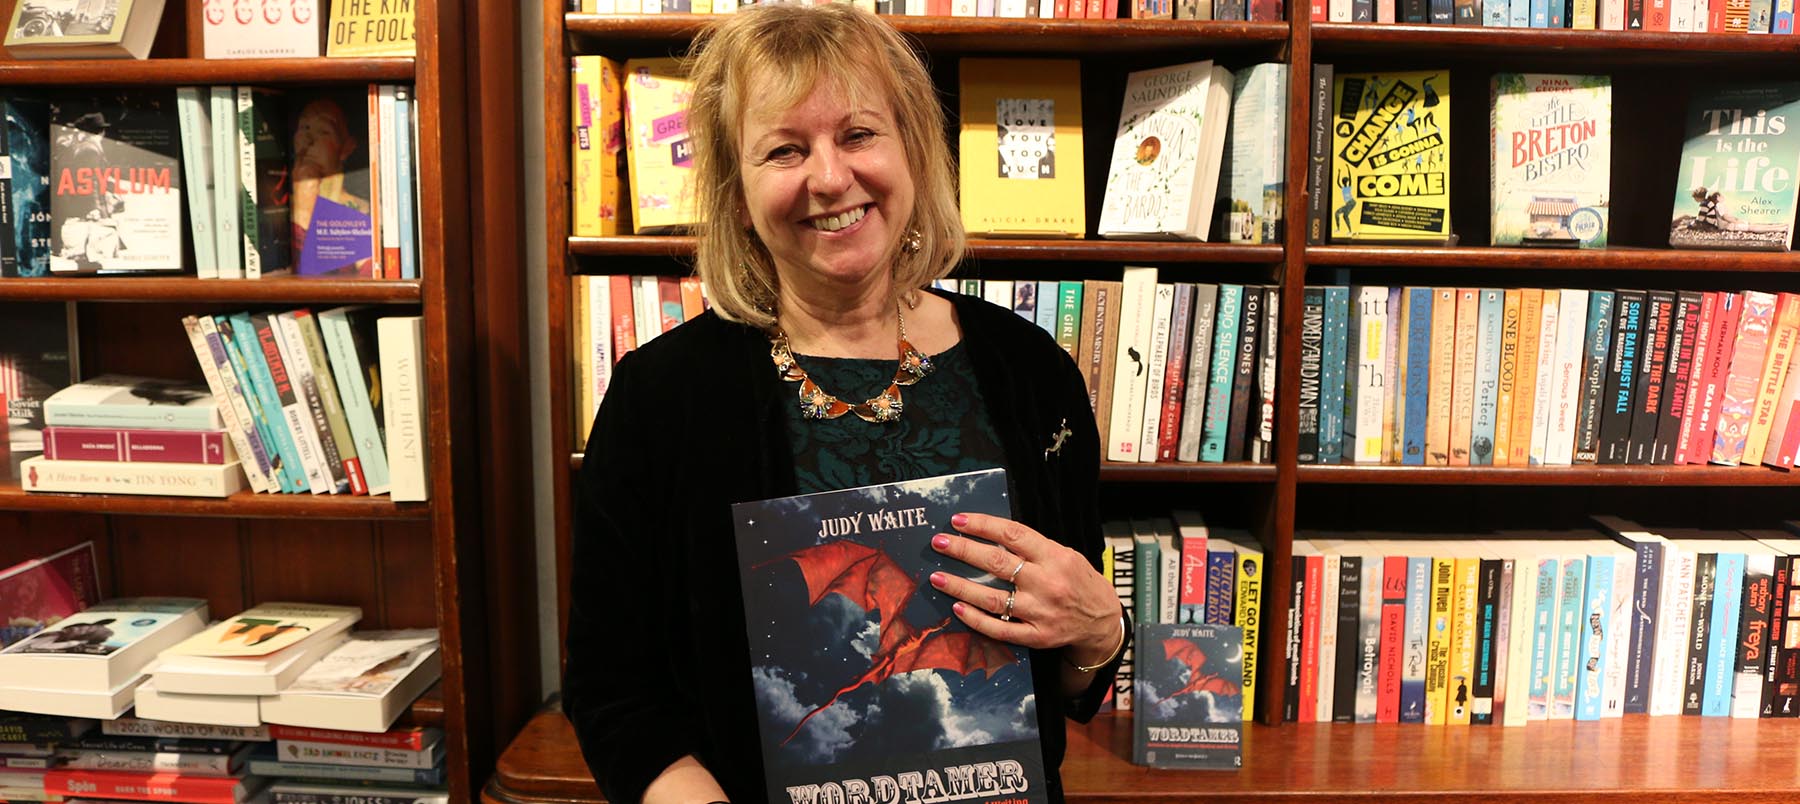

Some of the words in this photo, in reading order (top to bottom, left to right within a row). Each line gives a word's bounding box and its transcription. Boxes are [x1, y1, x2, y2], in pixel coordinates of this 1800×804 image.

[1131, 84, 1200, 104] SAUNDERS
[1143, 72, 1192, 90] GEORGE
[1316, 78, 1326, 90] The
[1542, 79, 1569, 87] NINA
[1316, 91, 1326, 120] Children
[1532, 103, 1585, 128] LITTLE
[1003, 119, 1046, 127] LOVE
[1346, 86, 1410, 163] CHANGE
[1703, 109, 1787, 136] This
[1009, 135, 1042, 143] YOU
[1315, 130, 1324, 155] Jocasta
[1374, 154, 1389, 168] IS
[1389, 135, 1440, 160] GONNA
[1512, 119, 1596, 169] BRETON
[1716, 139, 1733, 154] is
[1737, 138, 1769, 154] the
[1009, 150, 1042, 158] TOO
[1526, 142, 1589, 181] BISTRO
[57, 167, 171, 197] ASYLUM
[1001, 163, 1050, 175] MUCH
[1313, 165, 1323, 187] Natalie
[1686, 155, 1791, 193] Life
[1359, 174, 1443, 197] COME
[1122, 193, 1163, 223] BARDO
[1312, 188, 1321, 210] Haynes
[1740, 204, 1781, 216] Shearer
[1750, 195, 1773, 205] Alex
[1094, 290, 1106, 334] ROHINTON
[1203, 303, 1212, 316] The
[1222, 287, 1238, 329] RADIO
[1245, 295, 1259, 333] SOLAR
[1599, 295, 1612, 315] The
[1620, 301, 1629, 318] KARL
[1628, 302, 1640, 330] SOME
[1687, 303, 1699, 312] A
[1157, 317, 1167, 330] THE
[1505, 308, 1519, 340] ONE
[1546, 314, 1556, 332] The
[1594, 319, 1608, 351] Good
[1619, 319, 1627, 330] OVE
[1654, 303, 1672, 349] DANCING
[1683, 314, 1698, 346] DEATH
[1092, 335, 1101, 364] MISTRY
[1152, 333, 1165, 366] ALPHABET
[1194, 317, 1211, 367] Forgiven
[1443, 325, 1455, 375] RACHEL
[1463, 324, 1476, 375] RACHEL
[1541, 334, 1554, 366] Living
[1624, 332, 1637, 358] RAIN
[1716, 321, 1729, 355] HERMAN
[1778, 329, 1792, 350] THE
[258, 326, 288, 384] VLADIMIR
[1215, 332, 1235, 384] SILENCE
[1240, 336, 1255, 375] BONES
[1613, 332, 1626, 373] KNAUSGAARD
[1654, 351, 1664, 363] IN
[1680, 348, 1691, 359] IN
[1152, 368, 1161, 376] OF
[1262, 358, 1276, 401] FIGHT
[1501, 343, 1517, 393] BLOOD
[1560, 362, 1573, 399] Serious
[1588, 356, 1604, 396] People
[1620, 360, 1634, 386] MUST
[1650, 365, 1663, 384] THE
[1677, 362, 1690, 381] THE
[1711, 357, 1721, 379] KOCH
[1765, 353, 1786, 395] BRITTLE
[398, 358, 414, 405] WOLF
[1151, 378, 1160, 400] BIRDS
[1171, 371, 1180, 394] LITTLE
[9, 397, 40, 409] Soviet
[1169, 396, 1178, 411] RED
[1440, 382, 1452, 421] JOYCE
[1461, 382, 1474, 421] JOYCE
[1477, 379, 1497, 427] Perfect
[1616, 390, 1630, 415] FALL
[1645, 386, 1660, 414] DARK
[1670, 382, 1686, 418] FAMILY
[1756, 400, 1773, 426] STAR
[12, 408, 36, 419] Milk
[289, 409, 304, 434] ROBERT
[1260, 403, 1274, 442] CLUB
[1557, 402, 1569, 433] Sweet
[1586, 399, 1596, 431] HANNAH
[401, 412, 418, 463] HUNT
[1165, 414, 1175, 440] CHAIRS
[296, 436, 312, 461] LITTELL
[1585, 432, 1593, 450] KENT
[57, 474, 78, 483] Hero
[134, 474, 157, 487] JIN
[160, 475, 197, 488] YONG
[819, 513, 861, 538] JUDY
[868, 507, 929, 533] WAITE
[1168, 560, 1177, 571] All
[1183, 555, 1205, 597] Anna
[1438, 562, 1453, 584] John
[1466, 566, 1477, 587] THE
[1680, 556, 1692, 577] ANN
[1777, 569, 1787, 582] LAST
[1168, 572, 1177, 594] that's
[1206, 565, 1222, 624] CHABON
[1218, 559, 1235, 624] MICHAEL
[1248, 580, 1260, 607] LET
[1698, 575, 1709, 607] MONEY
[1748, 583, 1761, 608] quinn
[1755, 577, 1772, 614] anthony
[1167, 595, 1176, 610] left
[1239, 580, 1249, 618] EDWARD
[1436, 587, 1451, 612] Niven
[1457, 584, 1467, 617] CLAIRE
[1464, 588, 1475, 610] END
[1674, 582, 1690, 637] PATCHETT
[1774, 599, 1784, 607] AT
[1167, 611, 1174, 620] to
[1246, 608, 1257, 627] GO
[1464, 613, 1473, 626] OF
[1774, 608, 1783, 618] THE
[1172, 628, 1191, 637] JUDY
[1192, 629, 1215, 638] WAITE
[1244, 629, 1256, 649] MY
[1388, 612, 1399, 643] DAVID
[1455, 620, 1465, 654] NORTH
[1463, 629, 1473, 650] THE
[1694, 618, 1705, 651] WORLD
[1743, 619, 1768, 661] freya
[1771, 618, 1782, 641] LOBSTER
[1242, 651, 1255, 688] HAND
[1361, 637, 1378, 695] Betrayals
[1385, 646, 1397, 695] NICHOLLS
[1462, 652, 1471, 674] DAY
[1689, 656, 1699, 687] PEARSON
[121, 723, 149, 733] 2020
[153, 724, 193, 735] WORLD
[199, 725, 215, 735] OF
[219, 726, 246, 737] WAR
[1147, 726, 1239, 744] WORDTAMER
[110, 741, 124, 750] Life
[786, 759, 1028, 804] WORDTAMER
